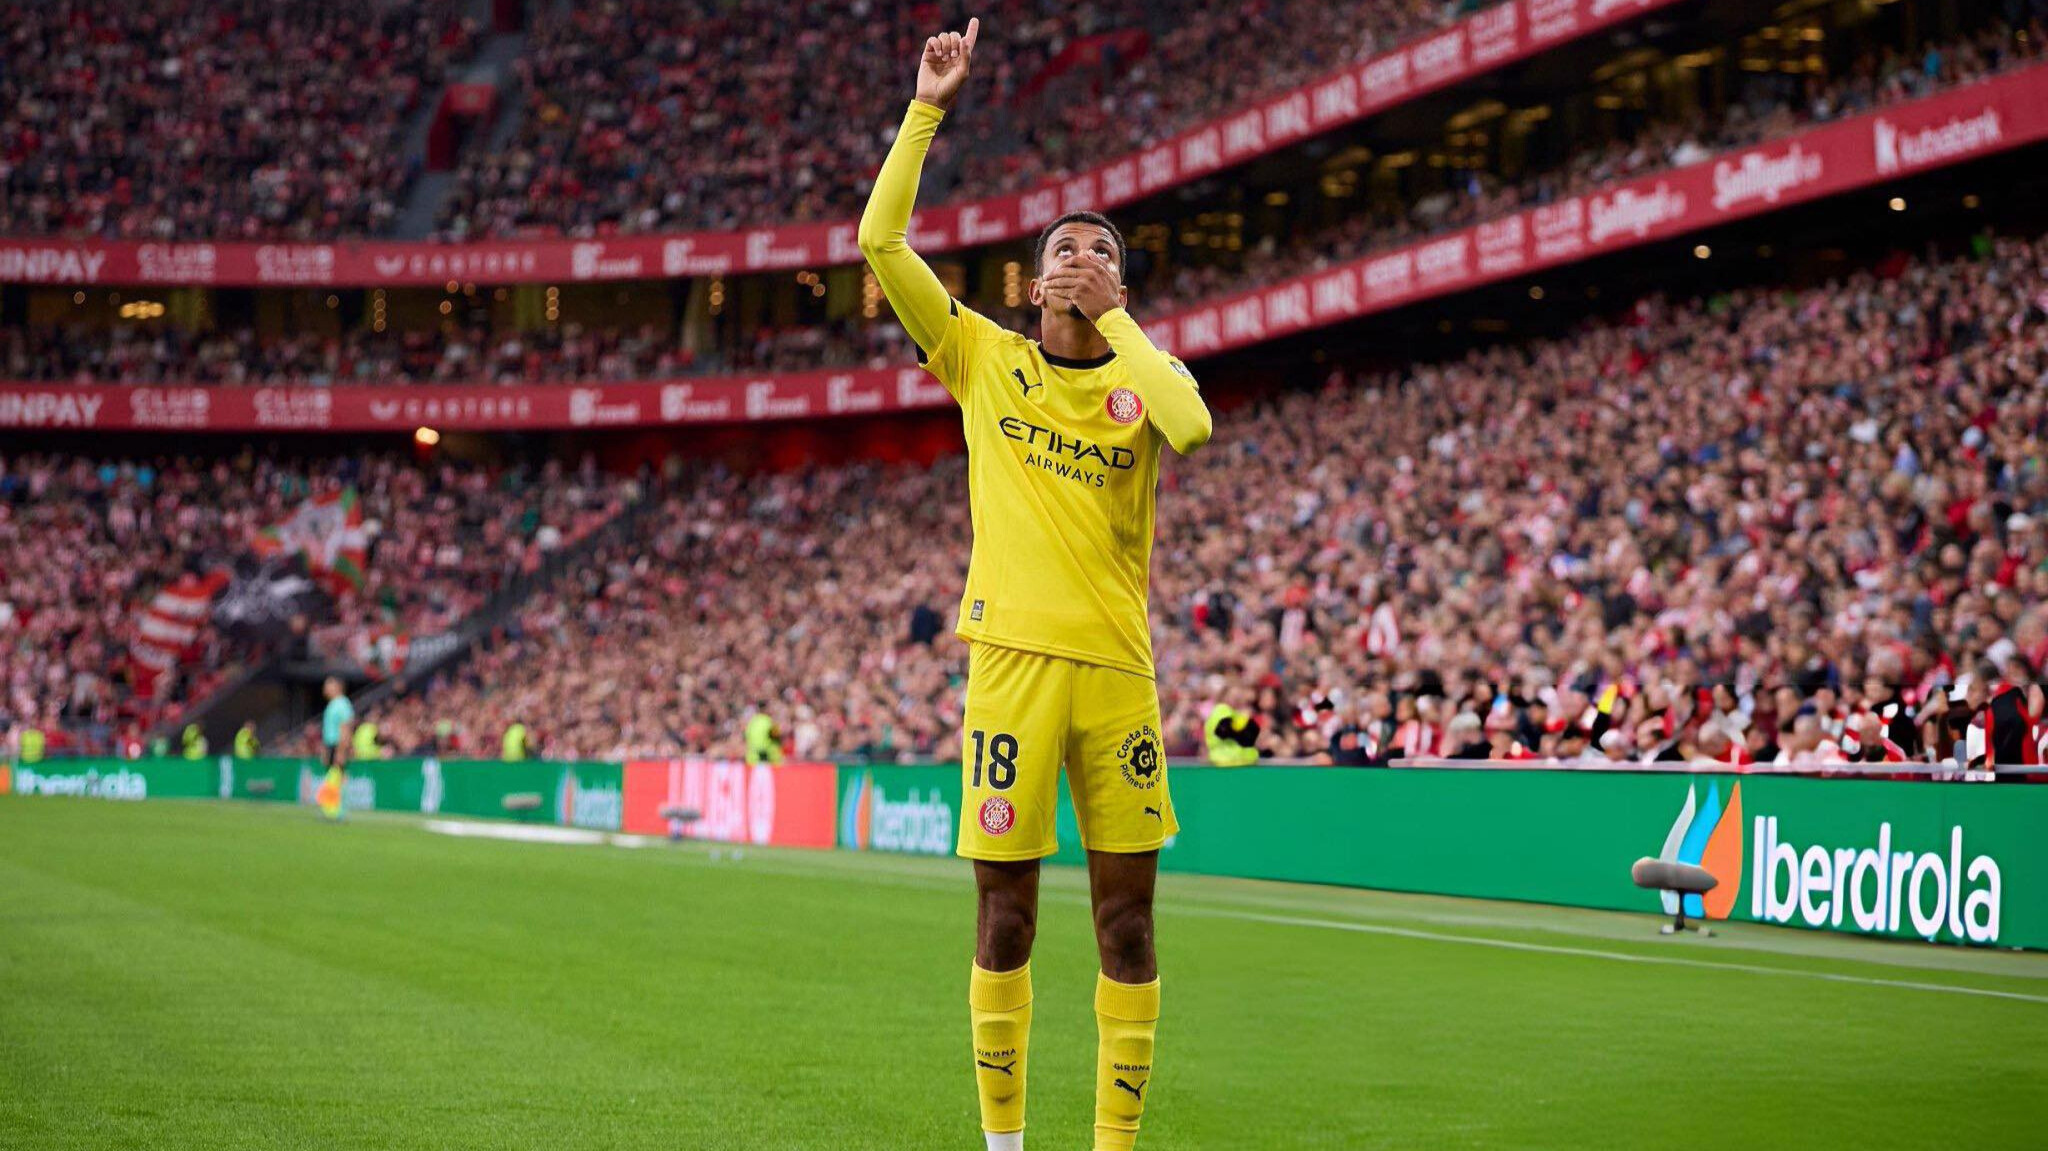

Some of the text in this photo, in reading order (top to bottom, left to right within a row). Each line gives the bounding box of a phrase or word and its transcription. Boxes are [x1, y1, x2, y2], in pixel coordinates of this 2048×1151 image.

[998, 416, 1135, 470] ETIHAD
[1025, 452, 1104, 488] AIRWAYS
[971, 730, 1019, 790] 18
[1116, 730, 1141, 759] Costa
[1119, 764, 1144, 789] Pirineu
[1146, 780, 1155, 789] de
[1752, 815, 2001, 942] Iberdrola
[976, 1048, 1017, 1058] GIRONA
[1112, 1062, 1151, 1072] GIRONA
